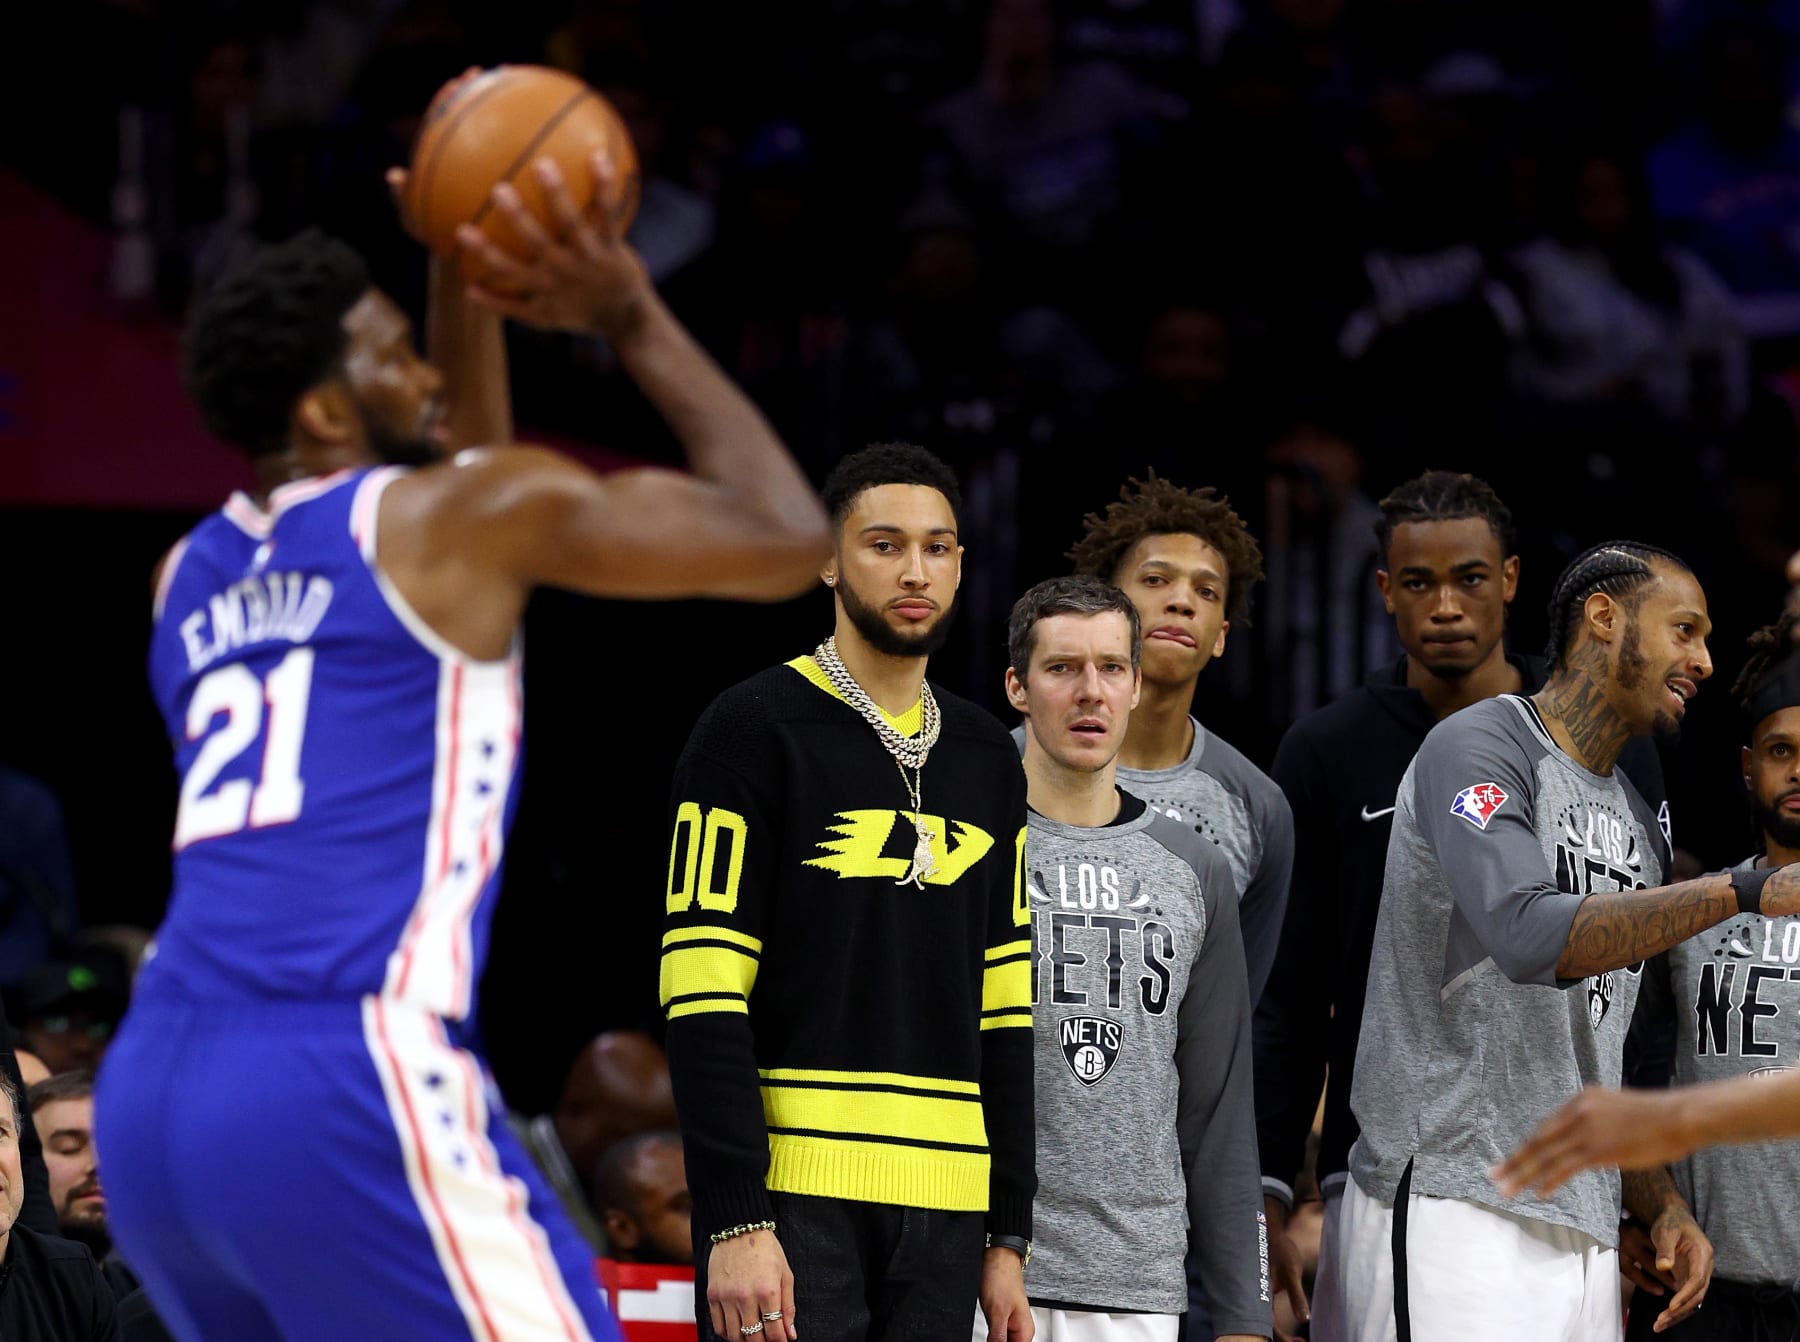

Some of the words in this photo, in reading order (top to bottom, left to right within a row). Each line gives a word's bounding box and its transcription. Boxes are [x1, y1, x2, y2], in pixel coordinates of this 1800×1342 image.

[174, 647, 315, 851] 21
[666, 801, 748, 915] 00
[1586, 810, 1623, 866] LOS
[1058, 863, 1120, 911] LOS
[1031, 911, 1176, 1017] ETS
[1694, 962, 1800, 1058] NE
[1063, 1018, 1120, 1050] NETS
